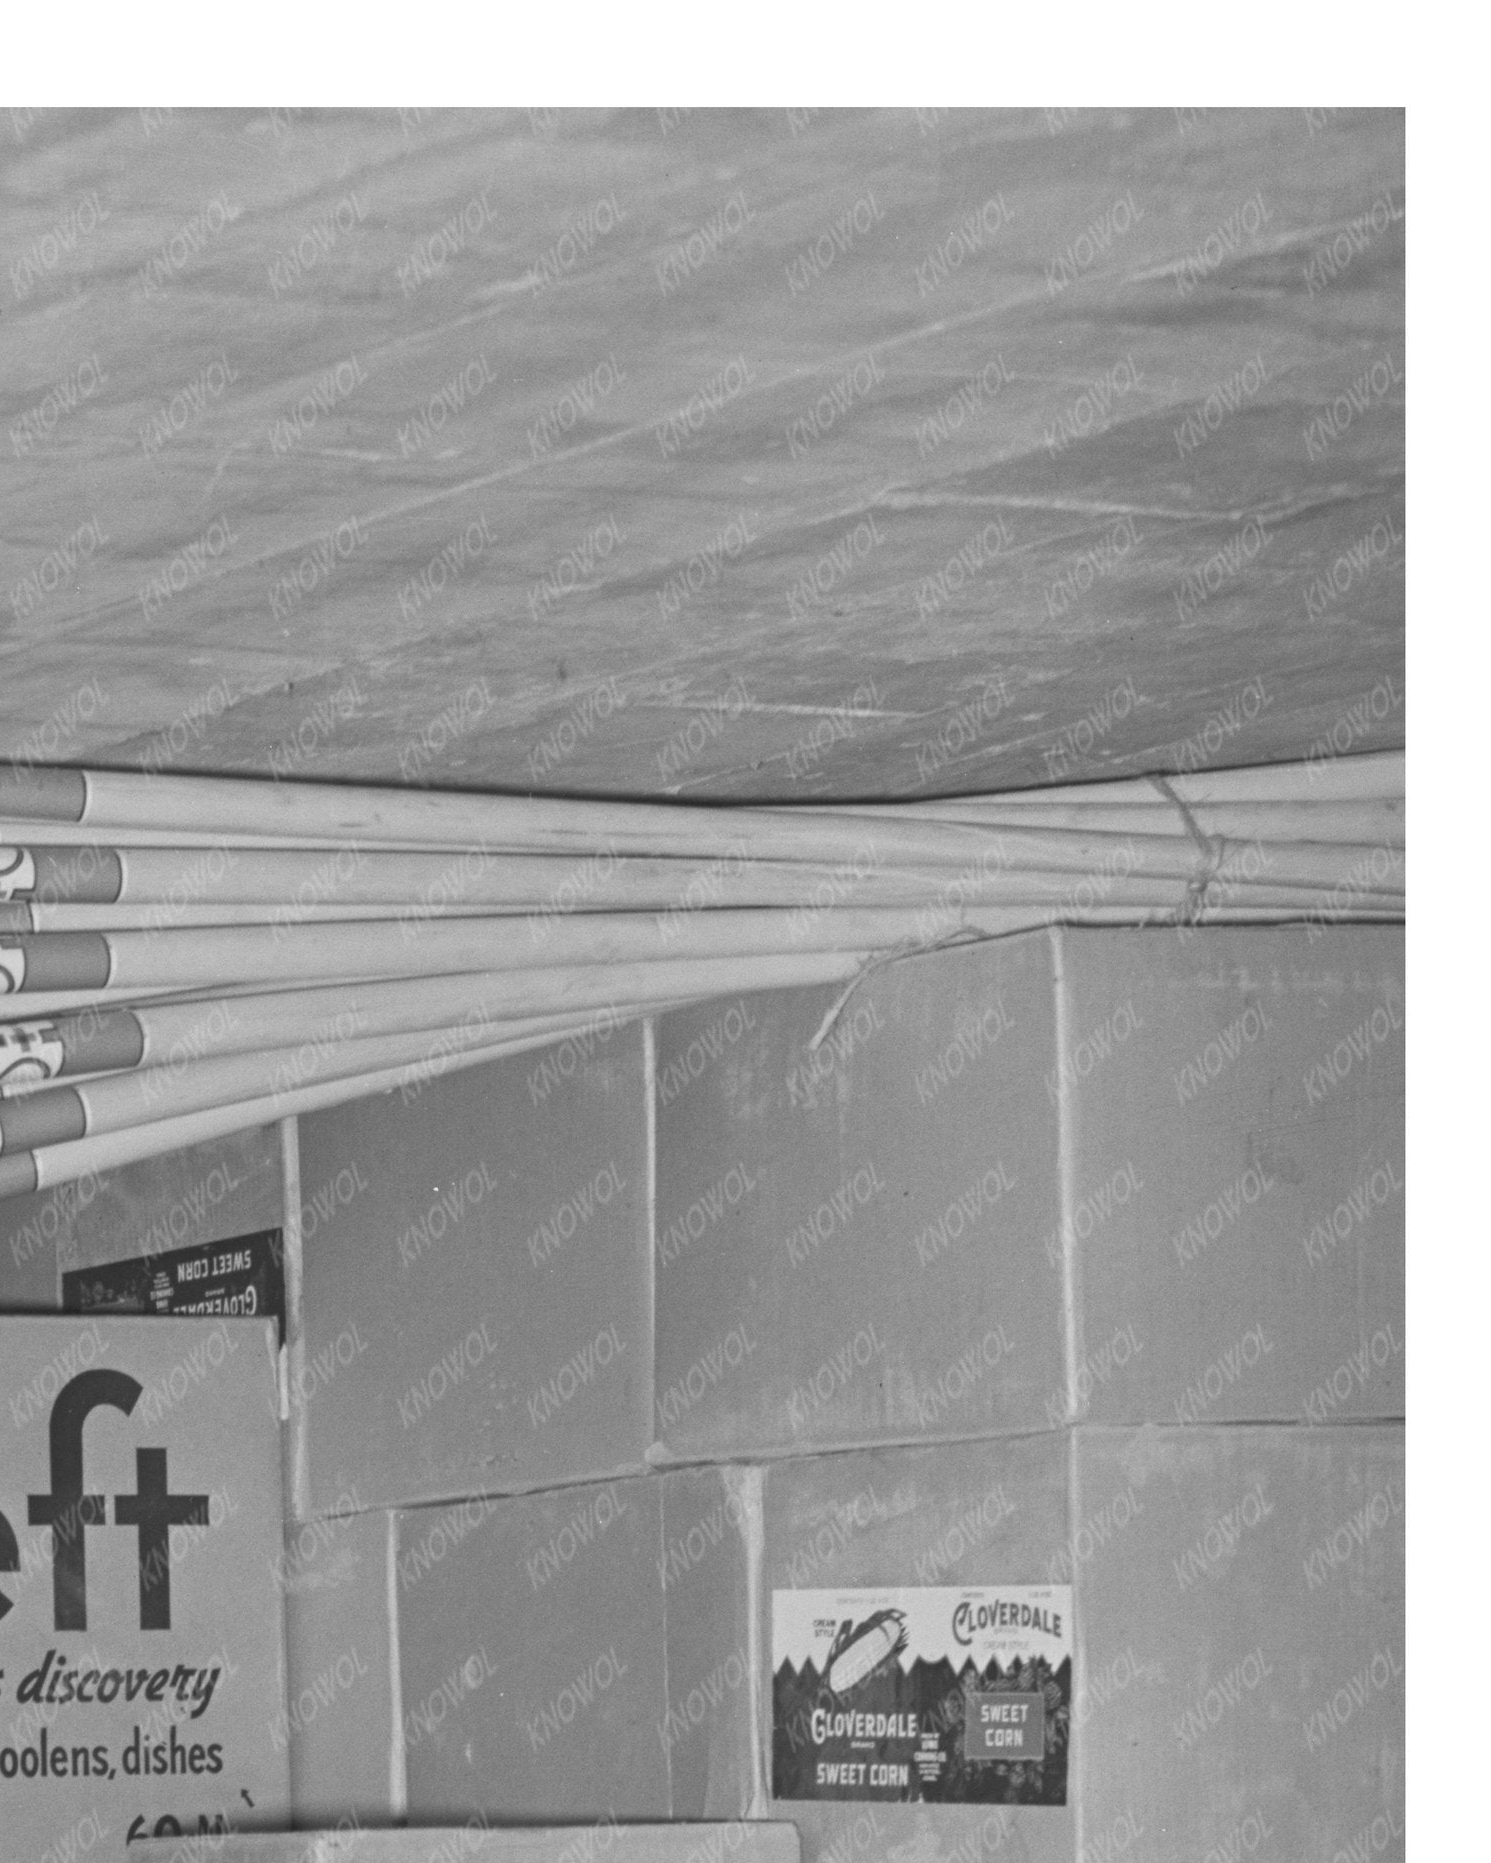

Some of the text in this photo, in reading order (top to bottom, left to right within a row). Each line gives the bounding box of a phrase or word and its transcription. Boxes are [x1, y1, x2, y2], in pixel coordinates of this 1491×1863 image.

[177, 1250, 252, 1281] SWEET CORN
[952, 1598, 1063, 1645] CLOVERDALE
[16, 1649, 220, 1719] discovery
[811, 1708, 918, 1745] CLOVERDALE
[122, 1725, 223, 1775] dishes
[817, 1763, 908, 1787] SWEET CORN
